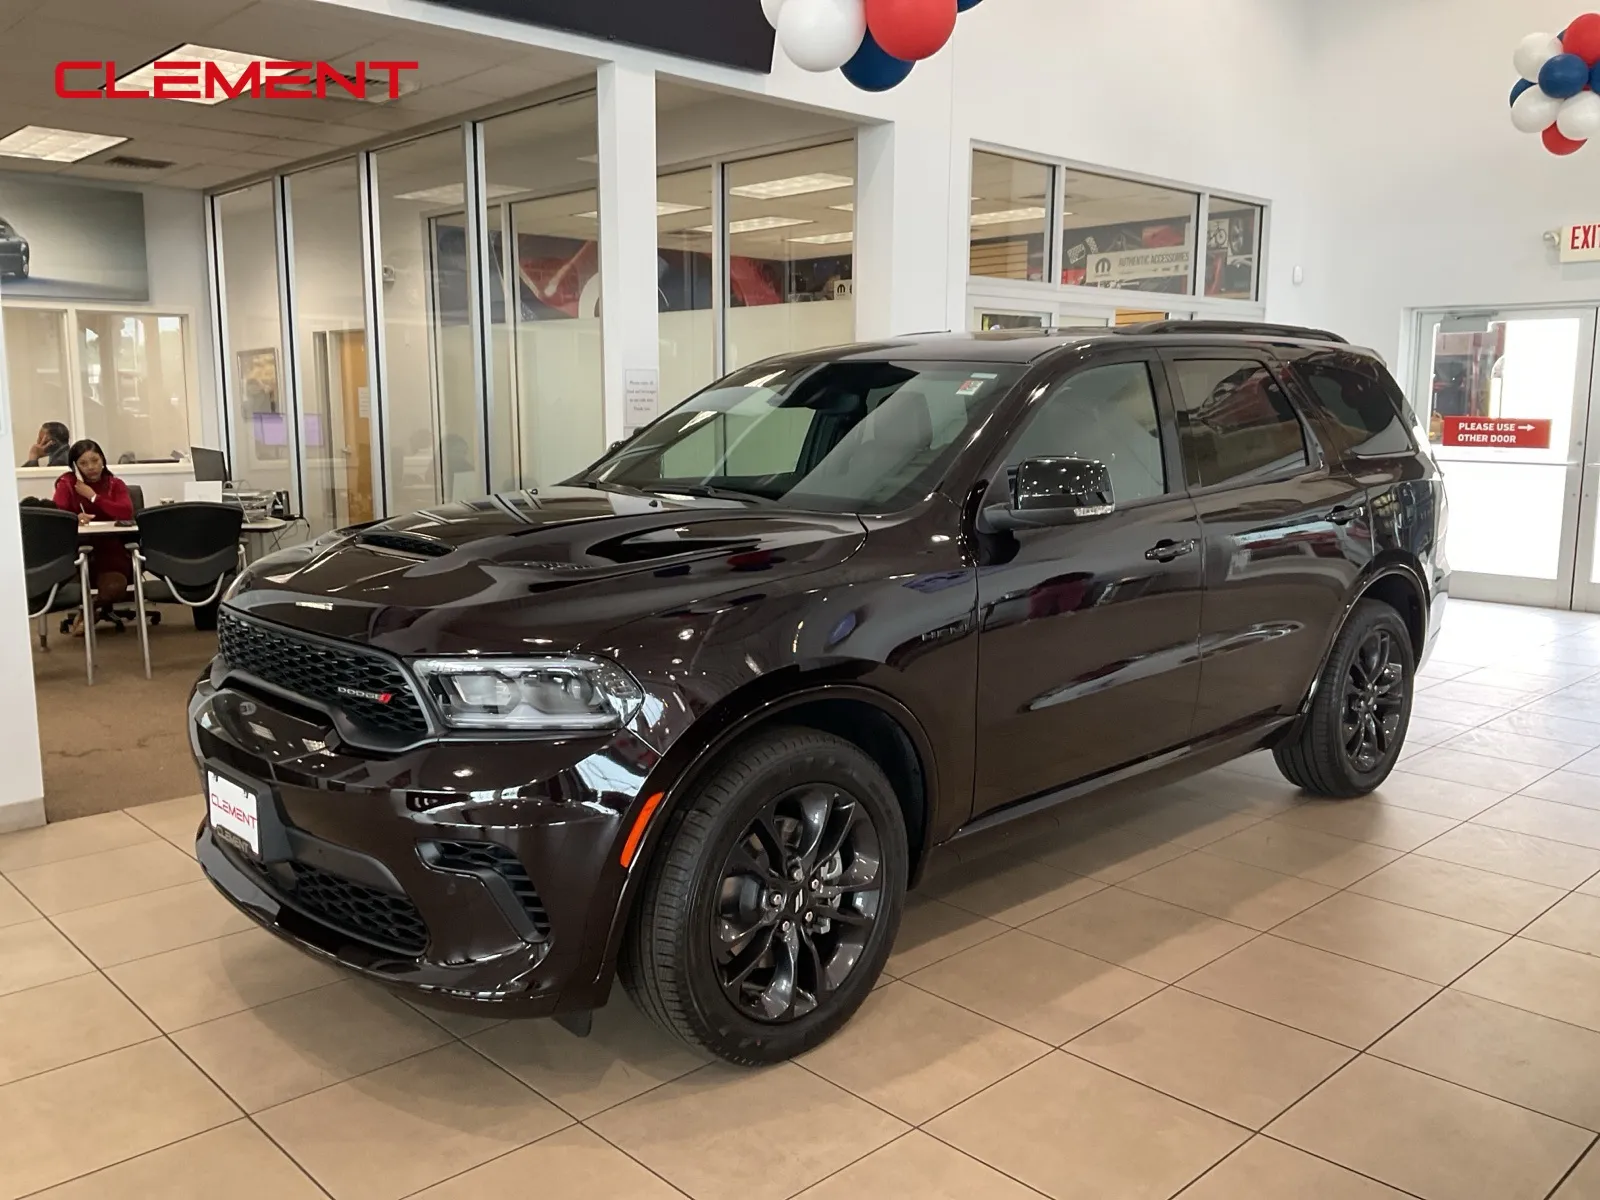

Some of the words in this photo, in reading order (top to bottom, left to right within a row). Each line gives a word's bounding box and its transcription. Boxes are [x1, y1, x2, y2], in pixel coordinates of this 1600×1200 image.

[1570, 223, 1600, 250] EXI
[1458, 422, 1495, 431] PLEASE
[1496, 423, 1516, 431] USE
[1457, 433, 1489, 443] OTHER
[1490, 434, 1517, 443] DOOR
[337, 686, 382, 700] DODGE
[211, 793, 258, 829] CLEMENT
[216, 826, 249, 853] CLEMENT
